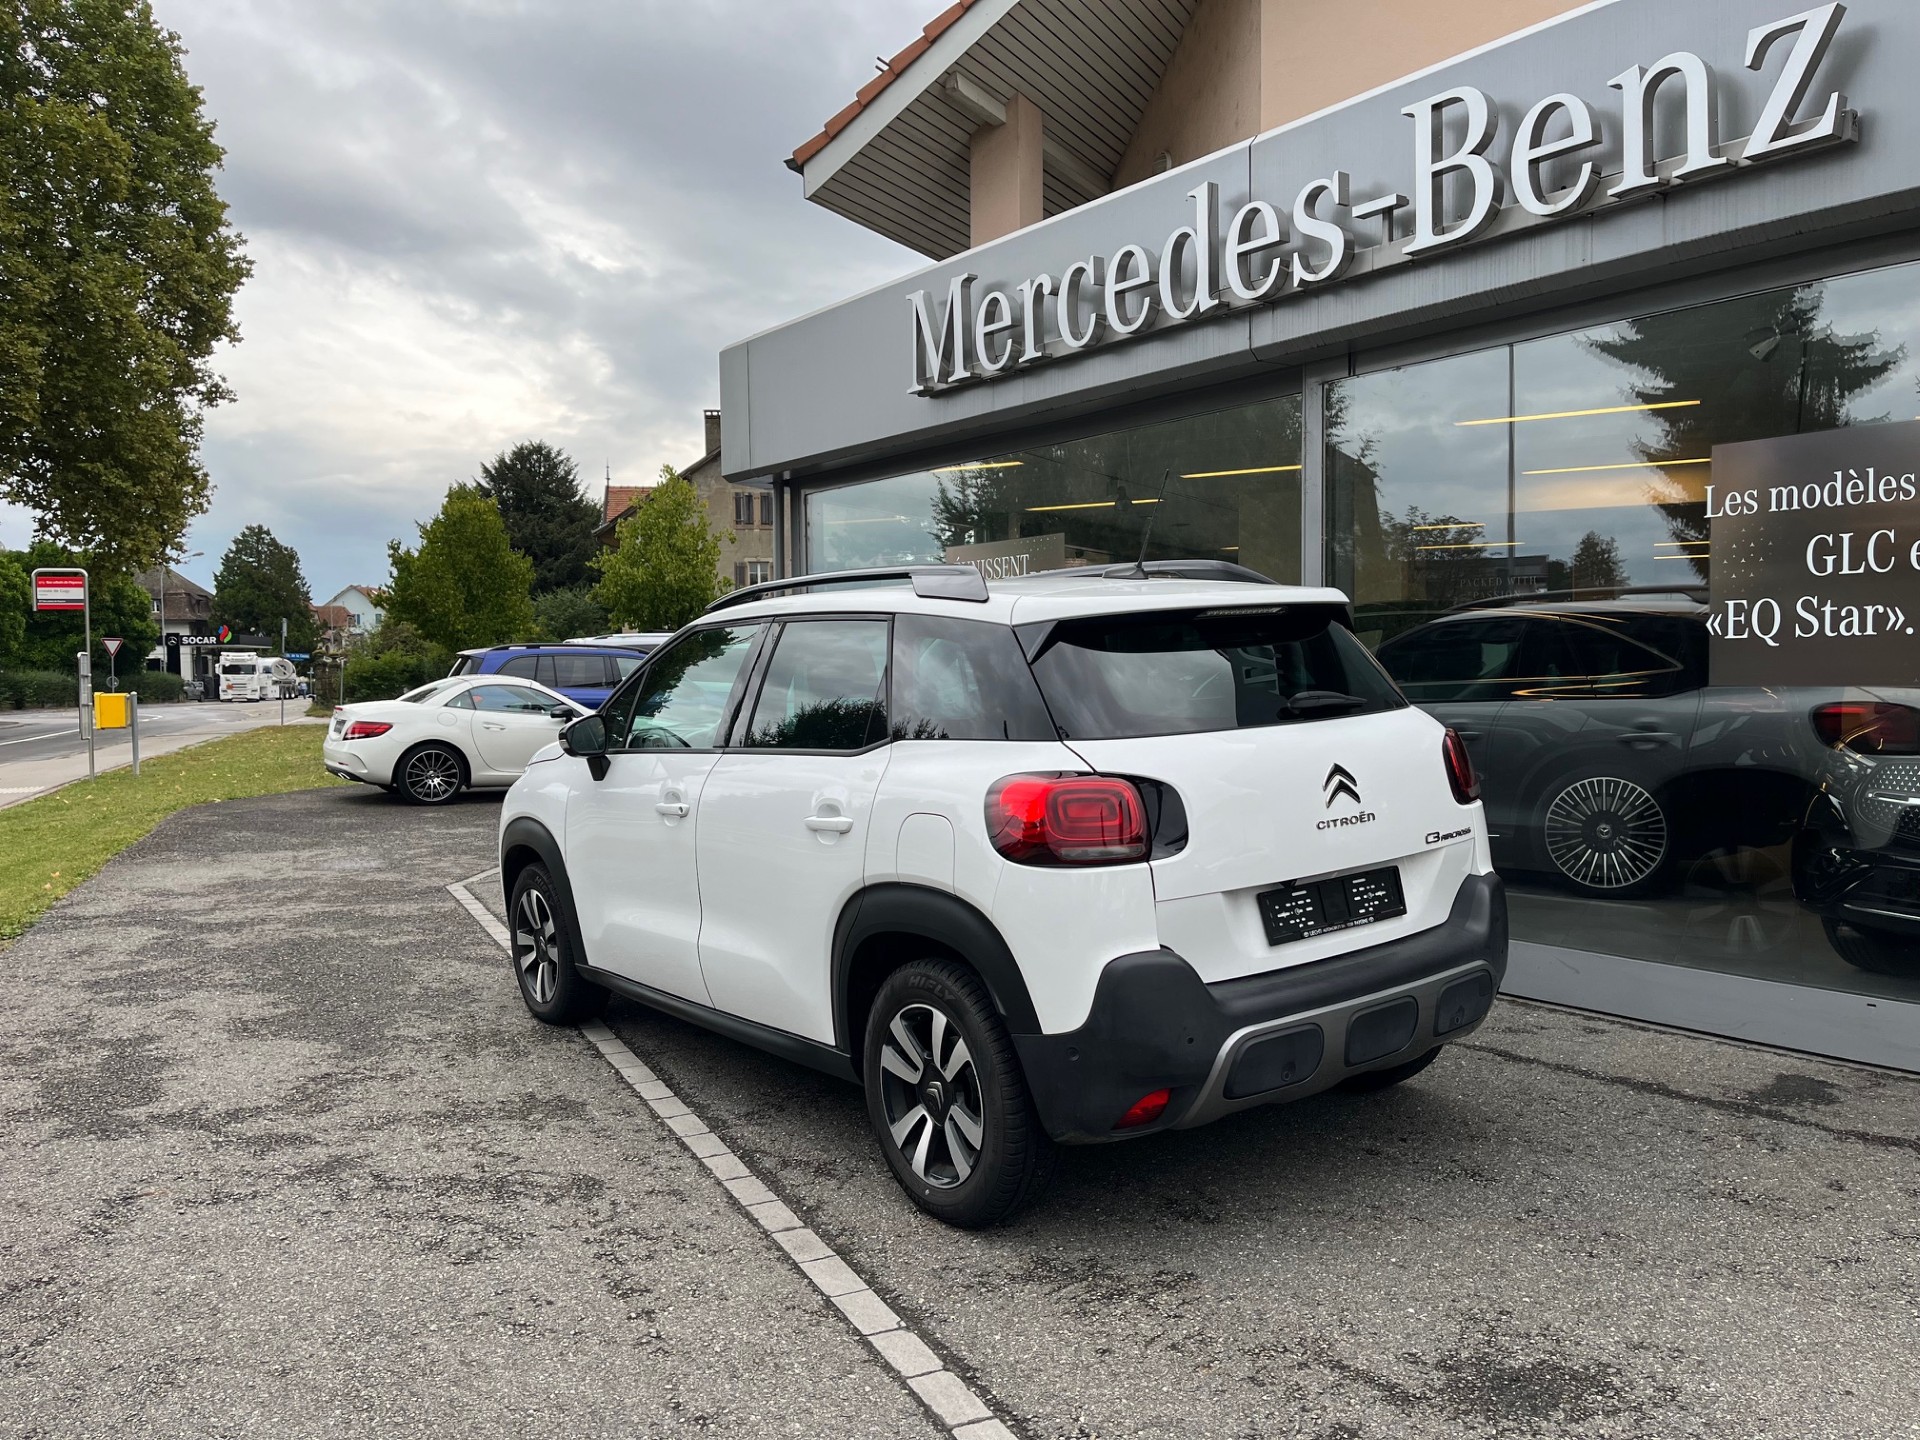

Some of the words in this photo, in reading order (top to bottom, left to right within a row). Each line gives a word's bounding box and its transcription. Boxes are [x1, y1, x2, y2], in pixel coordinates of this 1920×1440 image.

[907, 2, 1846, 397] Mercedes-Benz
[1704, 485, 1758, 518] Les
[1768, 467, 1916, 513] modèles
[1806, 528, 1896, 577] GLC
[182, 636, 217, 645] SOCAR
[1705, 598, 1781, 647] «EQ
[1795, 595, 1914, 638] Star».
[1316, 811, 1376, 830] CITROËN
